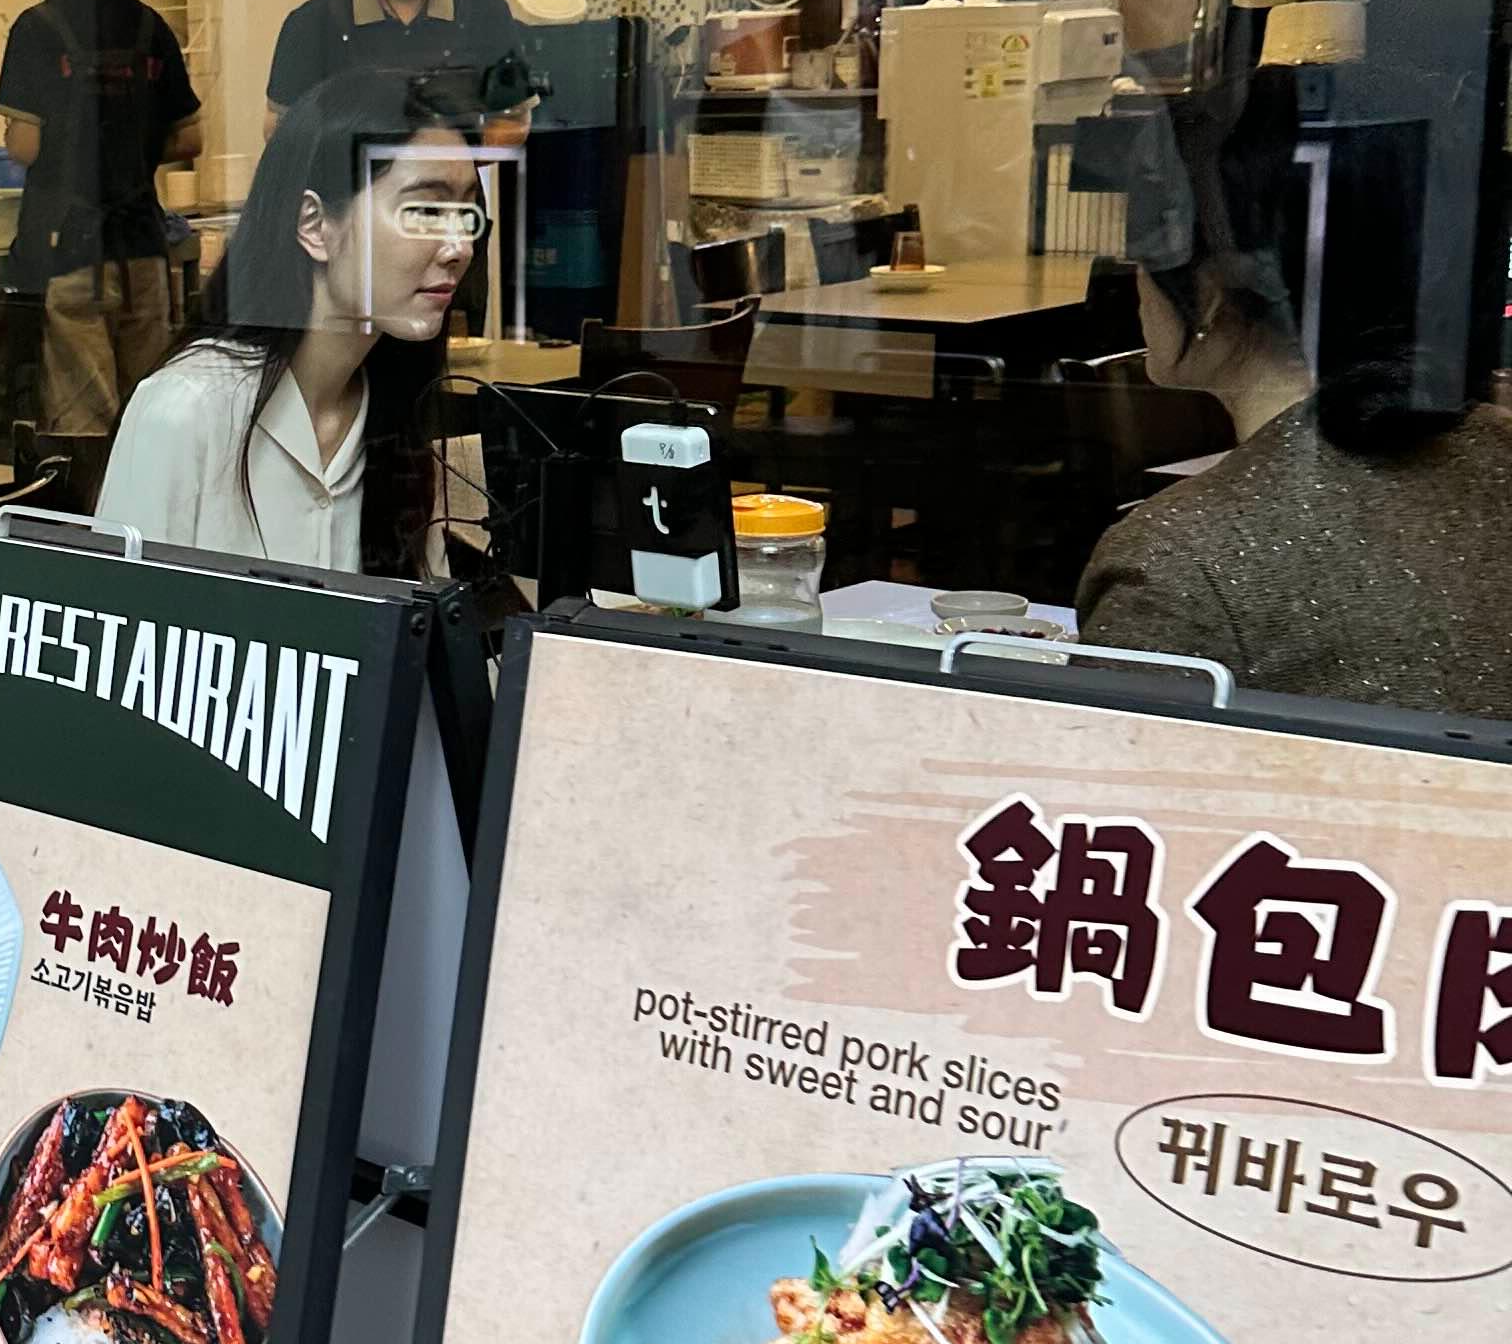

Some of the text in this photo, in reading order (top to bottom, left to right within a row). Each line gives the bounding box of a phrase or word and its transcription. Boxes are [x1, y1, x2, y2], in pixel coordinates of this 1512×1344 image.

[31, 958, 156, 1023] 소고기볶음밥
[40, 890, 240, 1007] 牛肉炒飯
[633, 986, 1061, 1112] pot-stirred pork slices
[659, 1028, 732, 1074] with
[744, 1050, 859, 1105] sweet
[870, 1082, 944, 1127] and
[1158, 1116, 1467, 1248] 꿔바로우
